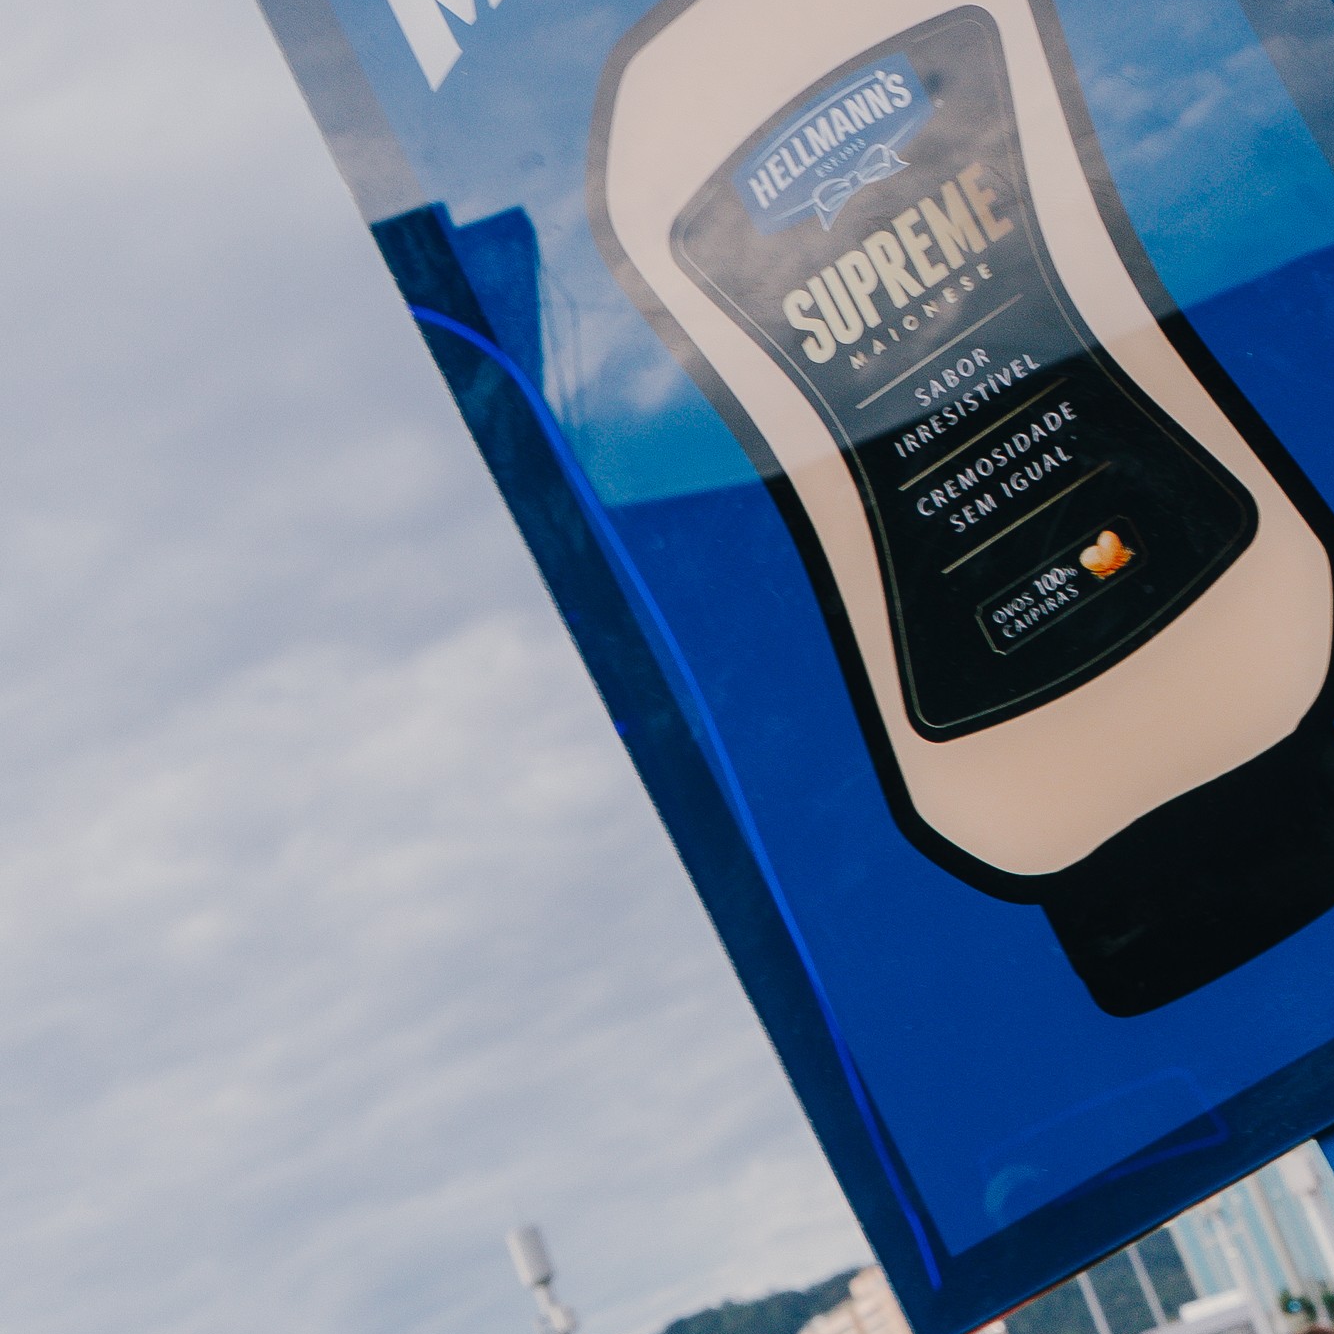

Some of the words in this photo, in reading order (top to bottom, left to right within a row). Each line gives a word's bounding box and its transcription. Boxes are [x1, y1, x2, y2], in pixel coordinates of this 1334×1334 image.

[748, 70, 912, 209] HELLMANN'S
[782, 162, 1014, 364] SUPREME
[849, 263, 993, 370] MAIONESE
[894, 354, 1041, 458] IRRESISTÍVEL
[914, 348, 990, 406] SABOR
[916, 401, 1077, 516] CREMOSIDADE
[950, 493, 998, 533] SEM
[1001, 446, 1073, 498] IGUAL
[992, 592, 1034, 624] OVOS
[1002, 584, 1079, 638] CAIPIRAS
